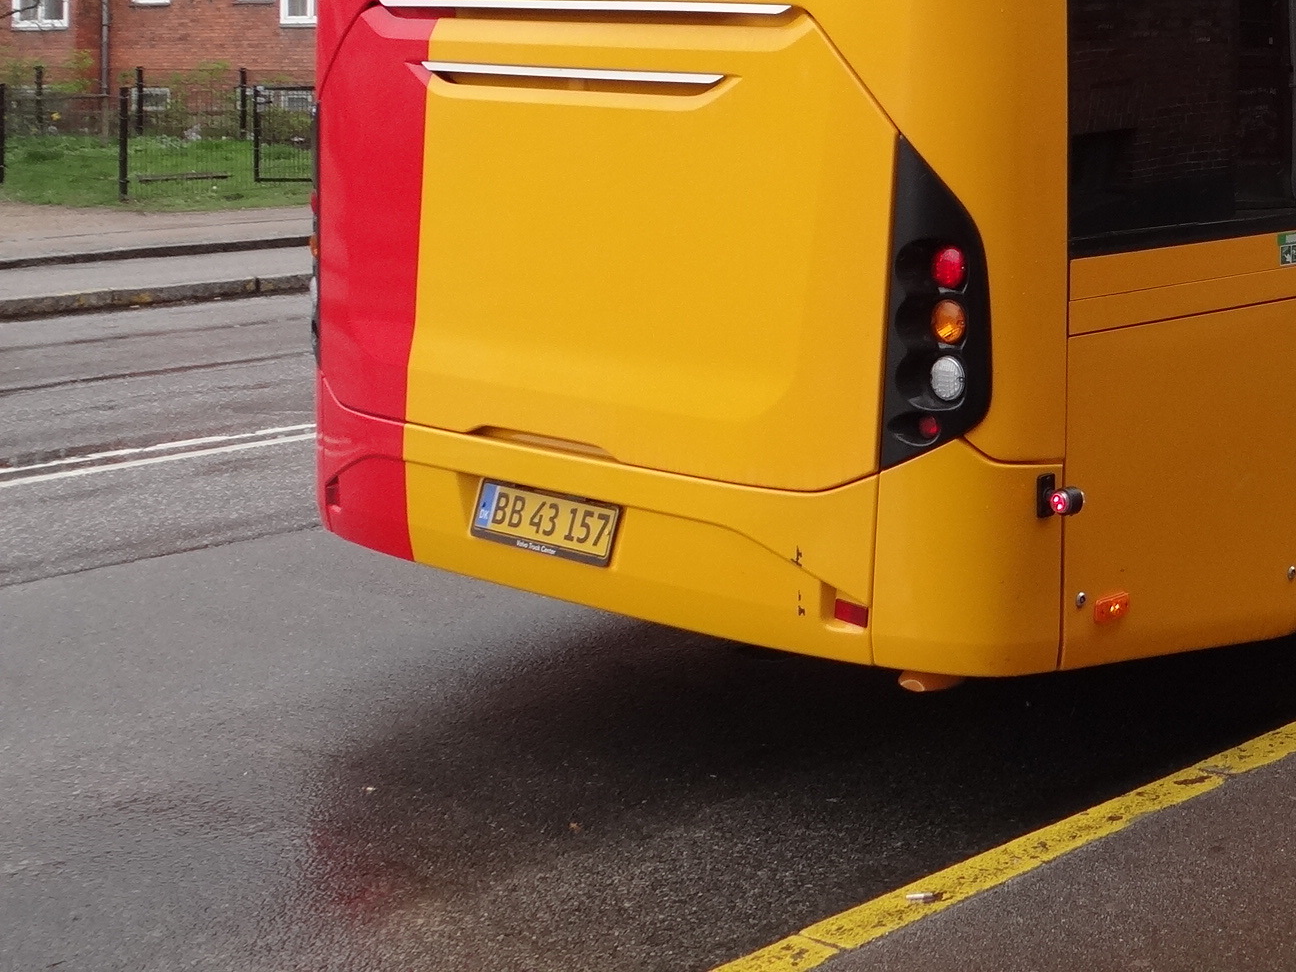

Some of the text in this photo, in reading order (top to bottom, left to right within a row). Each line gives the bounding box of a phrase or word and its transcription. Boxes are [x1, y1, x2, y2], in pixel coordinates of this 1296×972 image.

[478, 509, 490, 520] DK
[492, 491, 611, 547] BB 43 157
